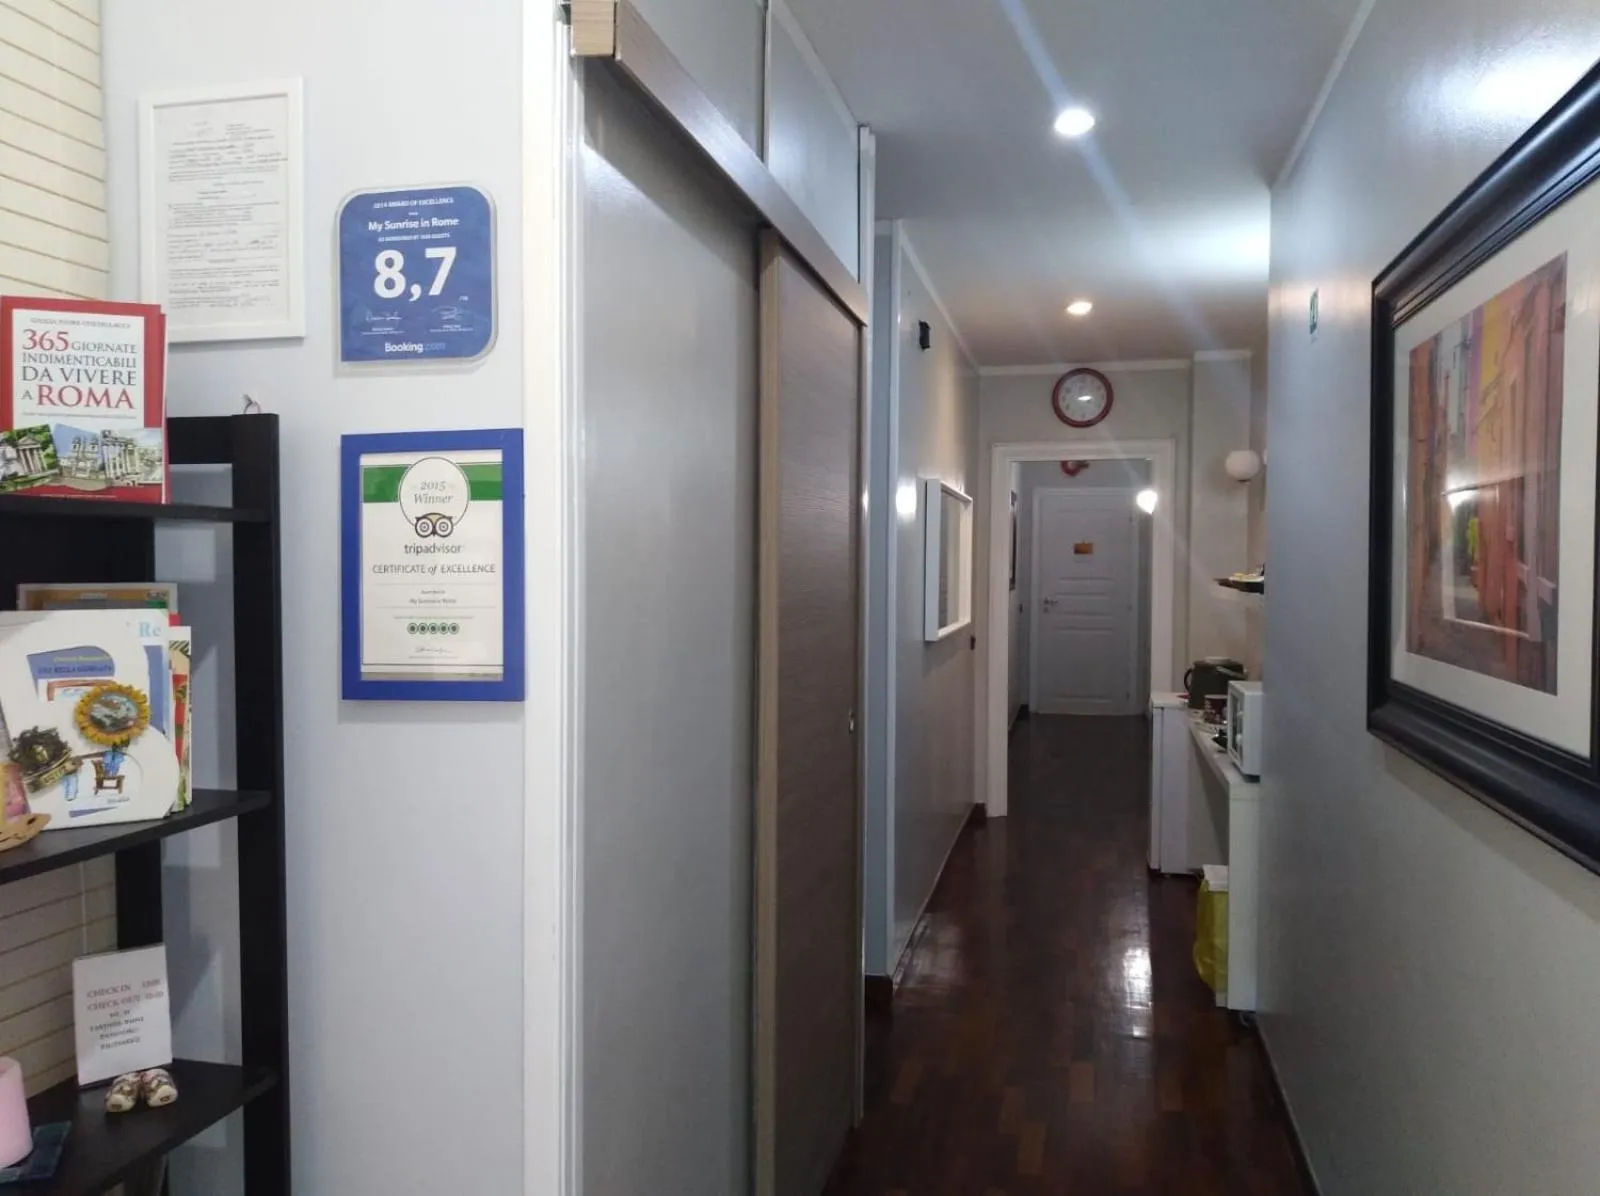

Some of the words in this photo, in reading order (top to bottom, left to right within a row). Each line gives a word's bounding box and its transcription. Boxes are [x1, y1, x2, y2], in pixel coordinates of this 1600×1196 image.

[368, 221, 383, 232] My
[384, 219, 419, 230] Sunrise
[420, 217, 430, 228] in
[431, 217, 460, 226] Rome
[374, 246, 457, 302] 8,7
[22, 328, 69, 352] 365
[71, 341, 137, 354] GIORNATE
[384, 341, 446, 353] Booking.com
[22, 351, 137, 369] INDIMENTICABILI
[22, 365, 54, 382] DA
[60, 367, 137, 386] VIVERE
[22, 389, 33, 400] A
[36, 384, 136, 410] ROMA
[419, 481, 447, 492] 2015
[413, 493, 454, 504] Winner
[404, 543, 462, 556] tripadvisor
[372, 564, 426, 575] CERTIFICATE
[427, 564, 438, 576] of
[440, 563, 496, 574] EXCELLENCE
[138, 621, 162, 638] Re
[87, 999, 120, 1011] CHECK
